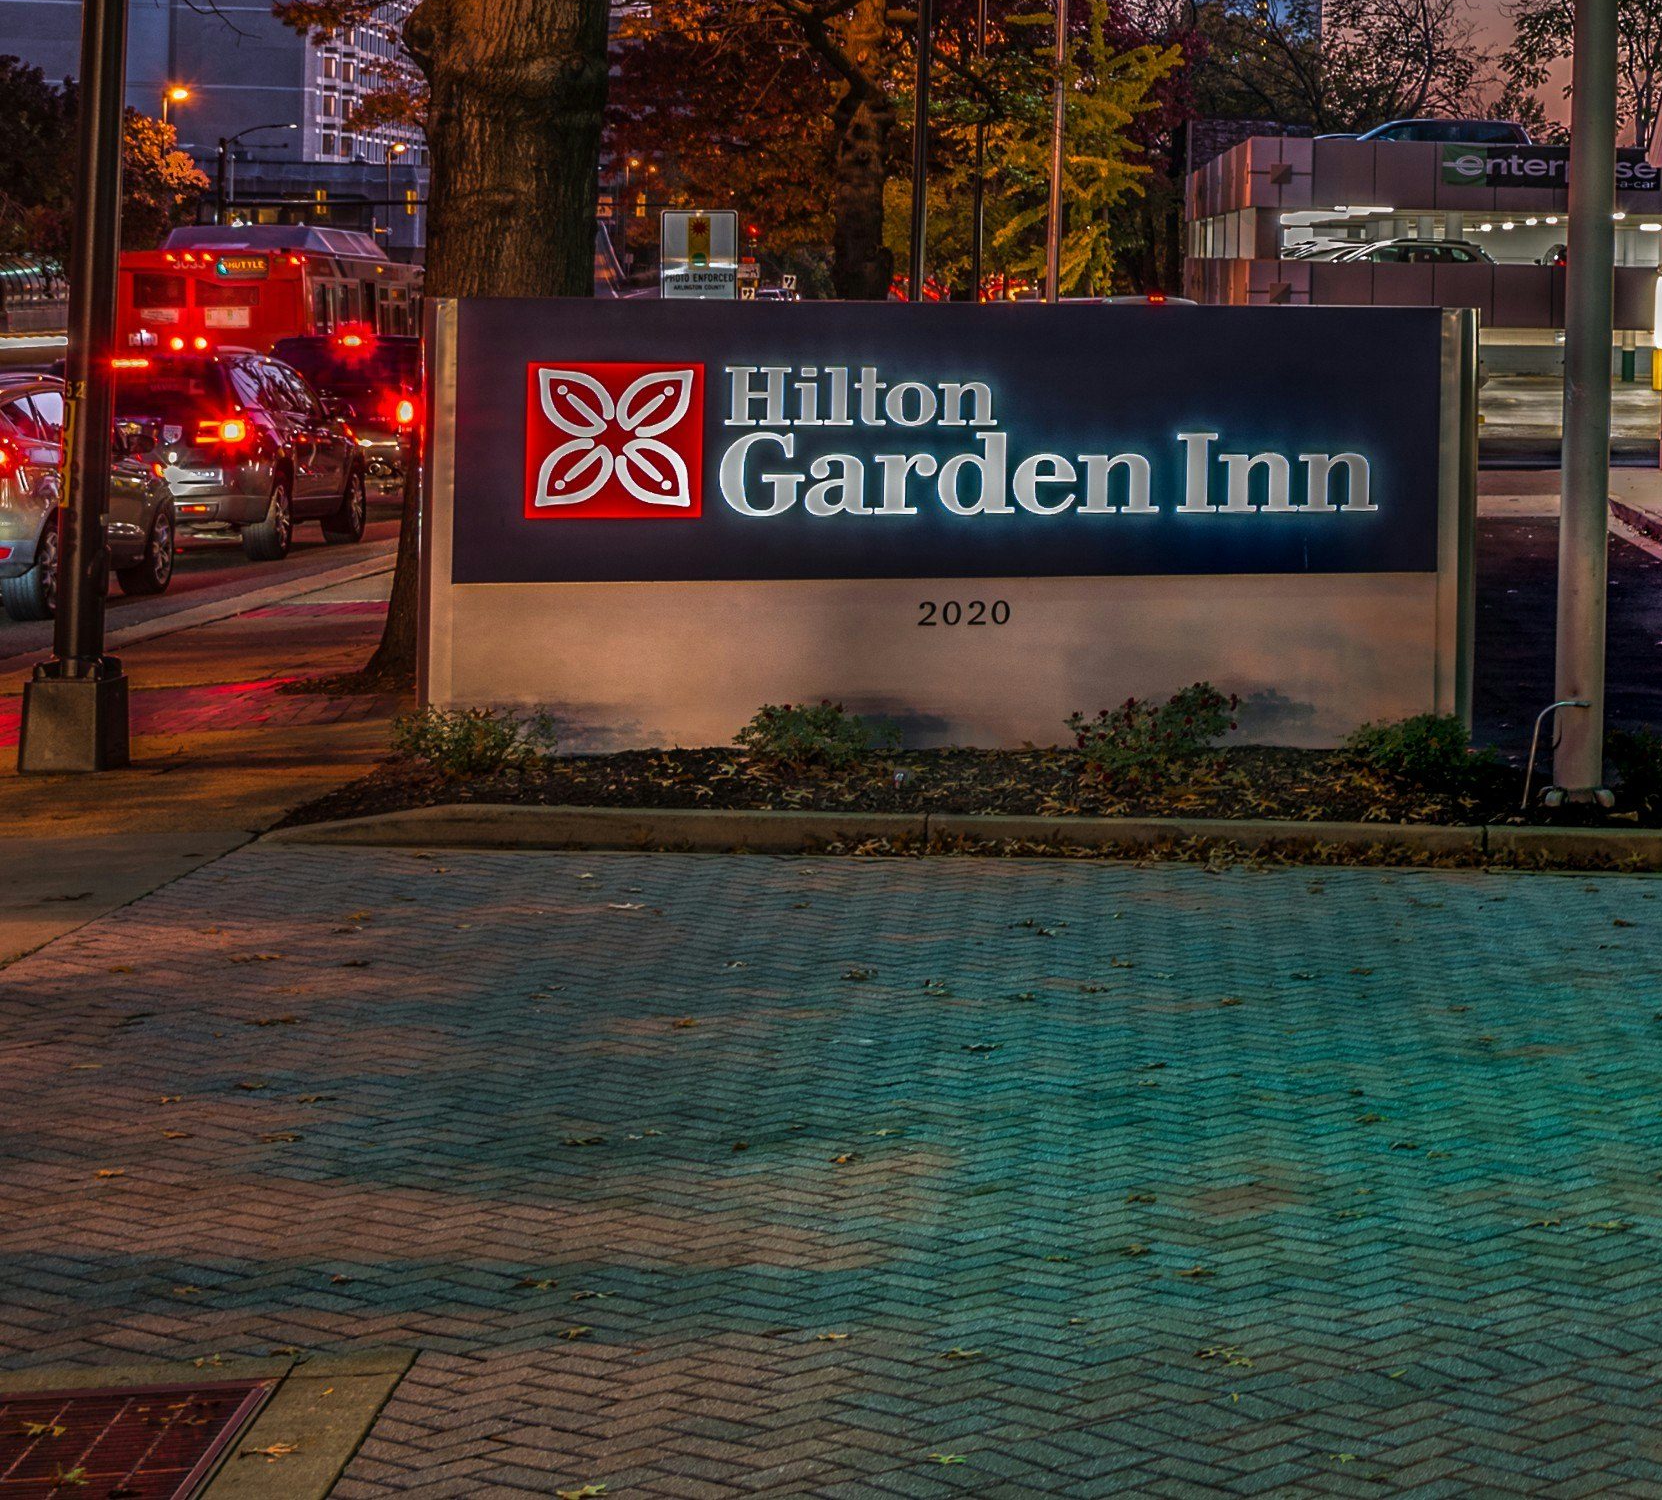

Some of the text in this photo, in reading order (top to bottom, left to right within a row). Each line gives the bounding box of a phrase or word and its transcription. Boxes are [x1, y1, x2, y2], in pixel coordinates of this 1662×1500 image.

[1456, 154, 1658, 183] enterse
[665, 273, 734, 283] PHOTO ENFORCED
[724, 366, 997, 426] Hilton
[719, 432, 1379, 517] Garden Inn
[918, 600, 1010, 626] 2020
